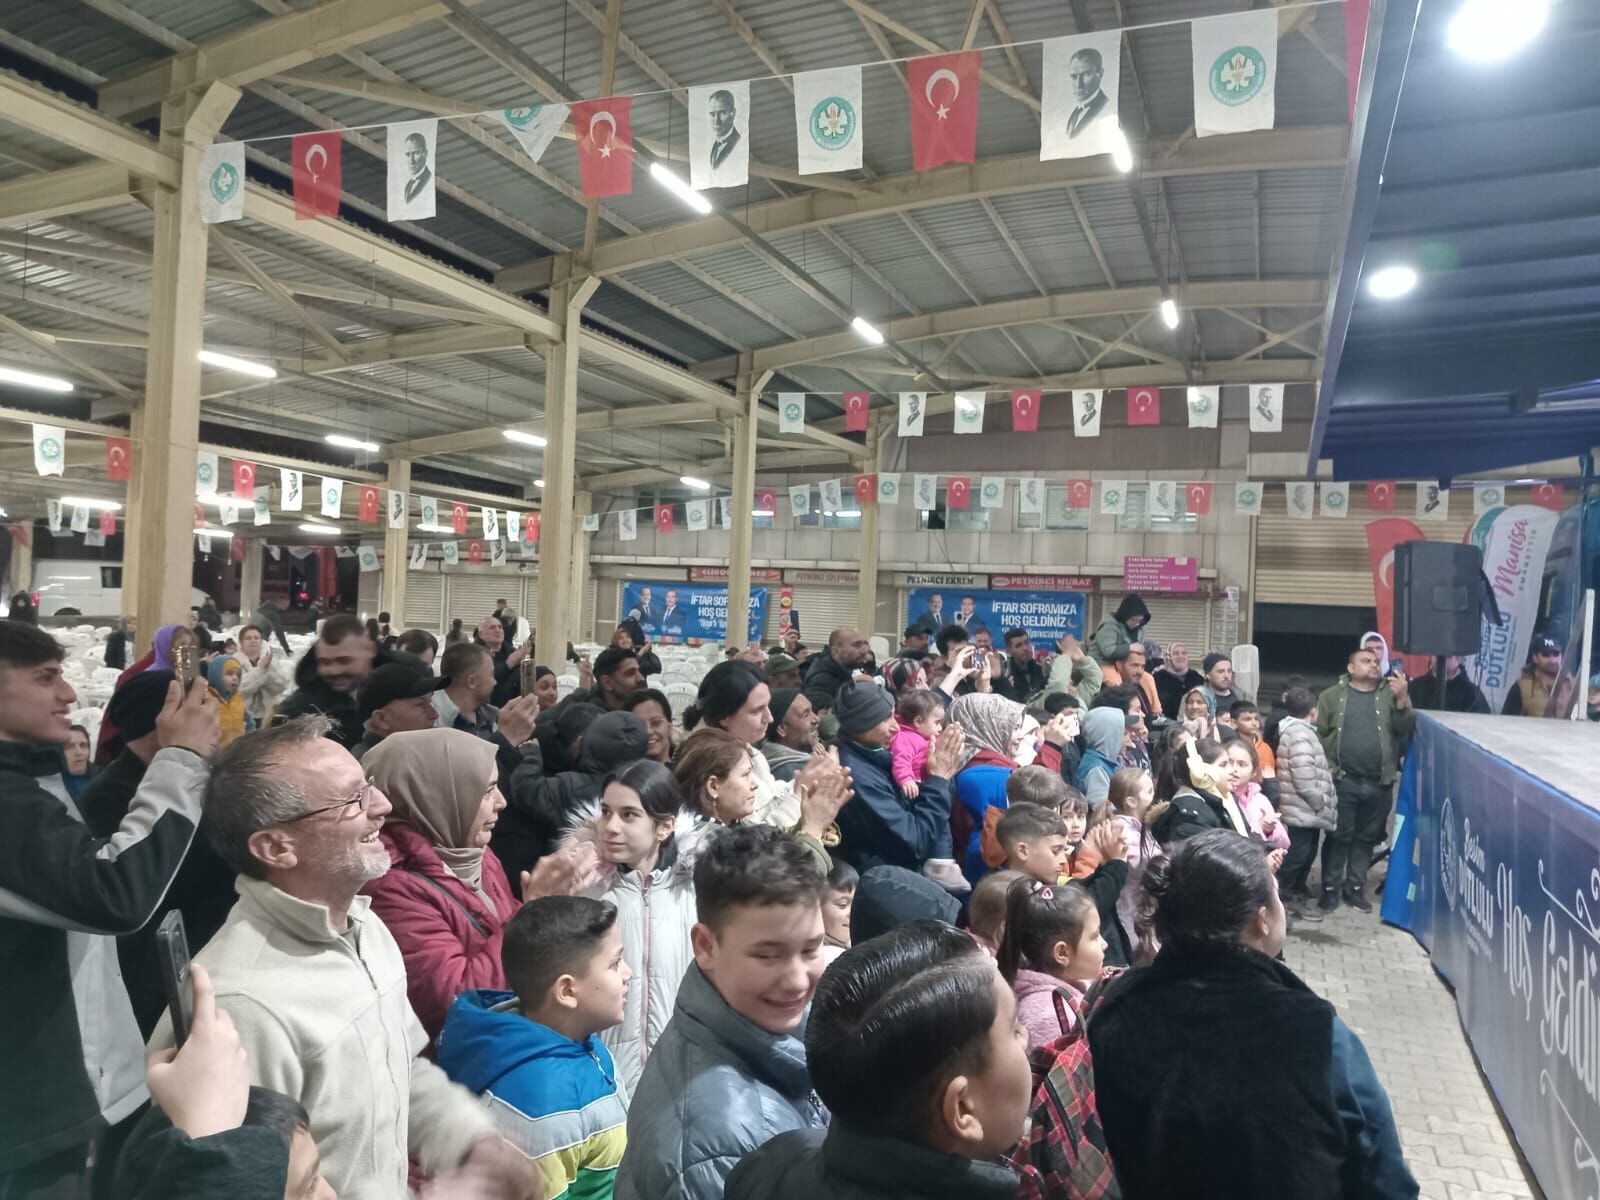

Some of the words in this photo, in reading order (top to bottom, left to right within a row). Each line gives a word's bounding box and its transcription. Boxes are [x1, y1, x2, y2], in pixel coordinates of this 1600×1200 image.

[1490, 518, 1529, 598] Manisa
[945, 576, 975, 586] EKREM
[1011, 576, 1055, 585] PEYNİRCİ
[1057, 578, 1092, 586] MURAT
[691, 592, 713, 606] İFTAR
[698, 607, 715, 620] HOŞ
[992, 600, 1019, 613] İFTAR
[1020, 602, 1077, 615] SOFRAMIZA
[1001, 614, 1021, 628] HOŞ
[1022, 614, 1067, 628] GELDİNİZ
[1464, 817, 1486, 873] Besim
[1459, 855, 1494, 939] DUTLULU
[1497, 862, 1533, 1022] Hoş
[1540, 909, 1600, 1104] Geldi
